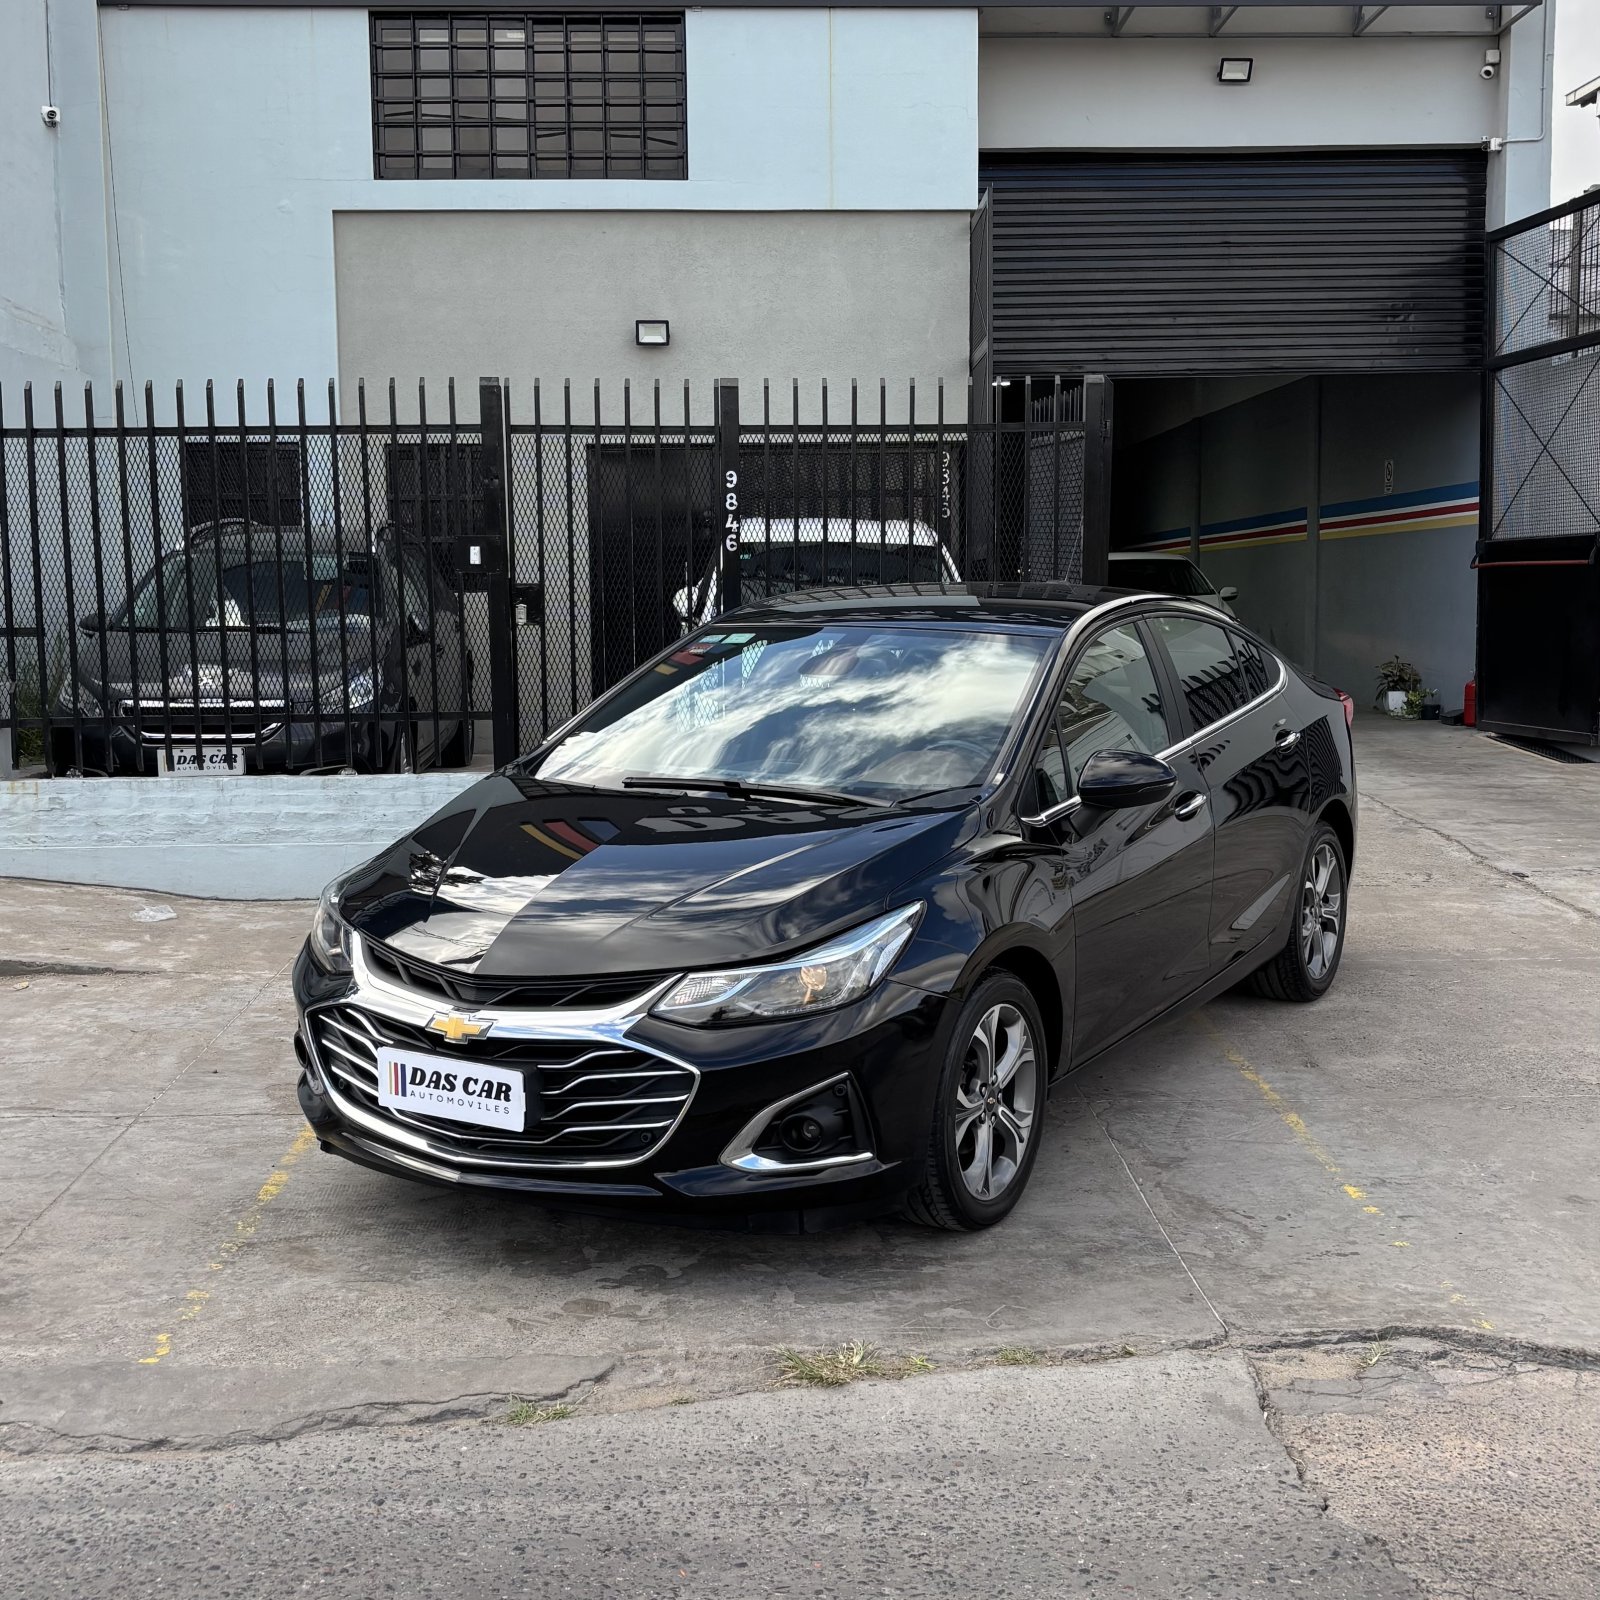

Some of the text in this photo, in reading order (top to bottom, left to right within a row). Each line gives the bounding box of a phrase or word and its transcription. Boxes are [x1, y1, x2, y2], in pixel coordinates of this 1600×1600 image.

[725, 470, 739, 552] 9846
[409, 1066, 512, 1103] DAS CAR
[410, 1090, 510, 1115] AUTOMOVILES
